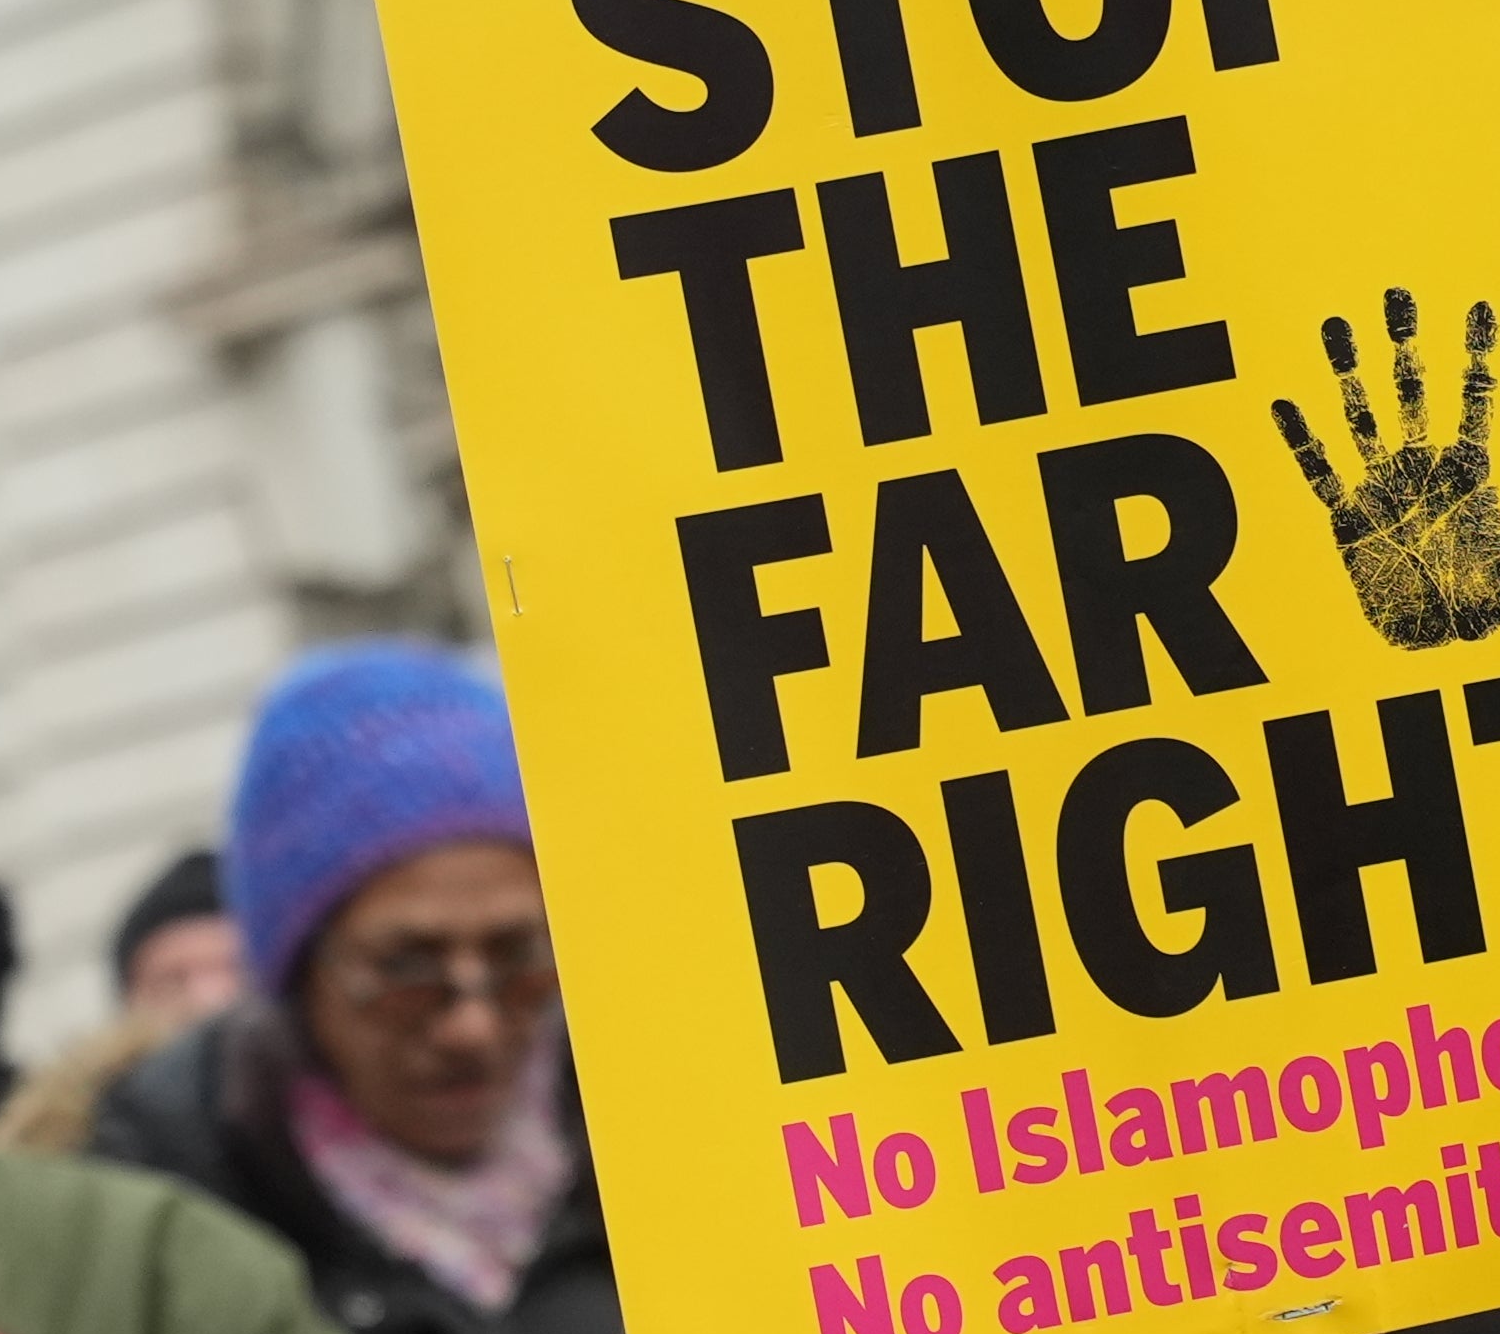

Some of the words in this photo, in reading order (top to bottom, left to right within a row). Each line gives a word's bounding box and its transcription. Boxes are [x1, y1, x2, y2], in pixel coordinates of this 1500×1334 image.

[609, 115, 1237, 473] THE
[675, 433, 1270, 783] FAR
[784, 1115, 935, 1225] No
